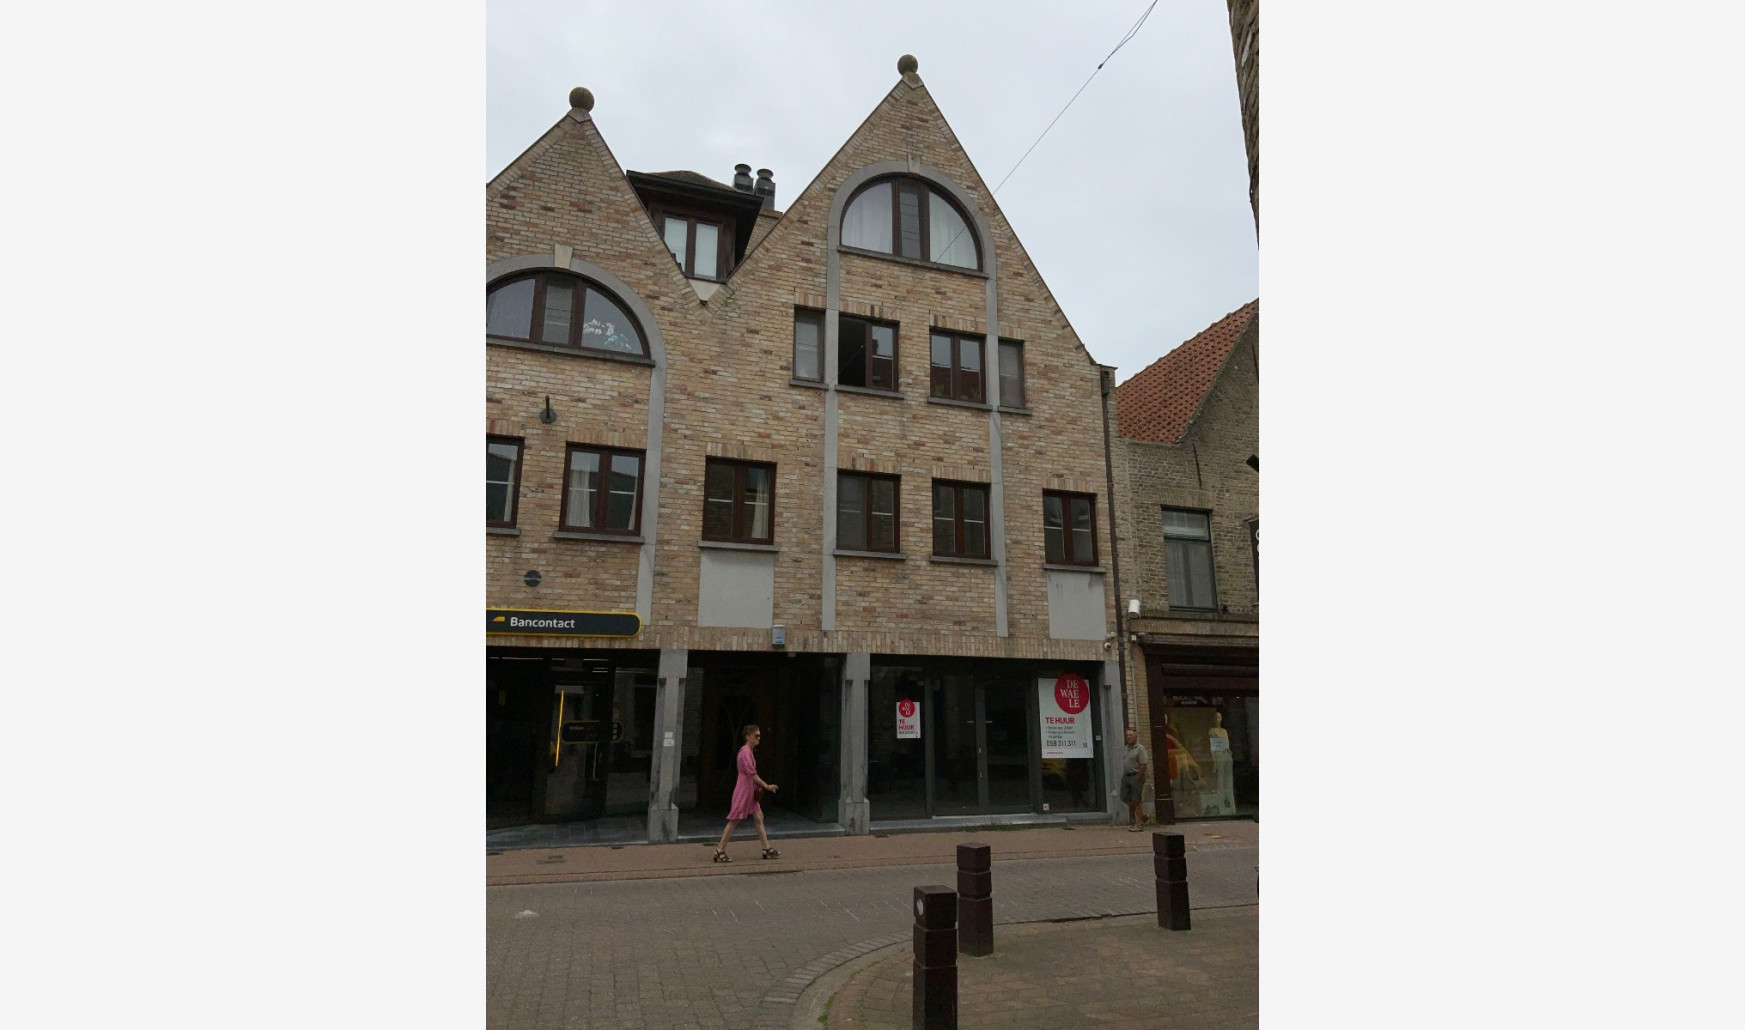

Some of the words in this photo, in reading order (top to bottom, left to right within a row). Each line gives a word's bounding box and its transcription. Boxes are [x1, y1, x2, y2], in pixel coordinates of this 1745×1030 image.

[510, 616, 576, 629] Bancontact
[1067, 680, 1078, 688] DE
[1060, 689, 1079, 698] WAE
[1069, 699, 1080, 708] LE
